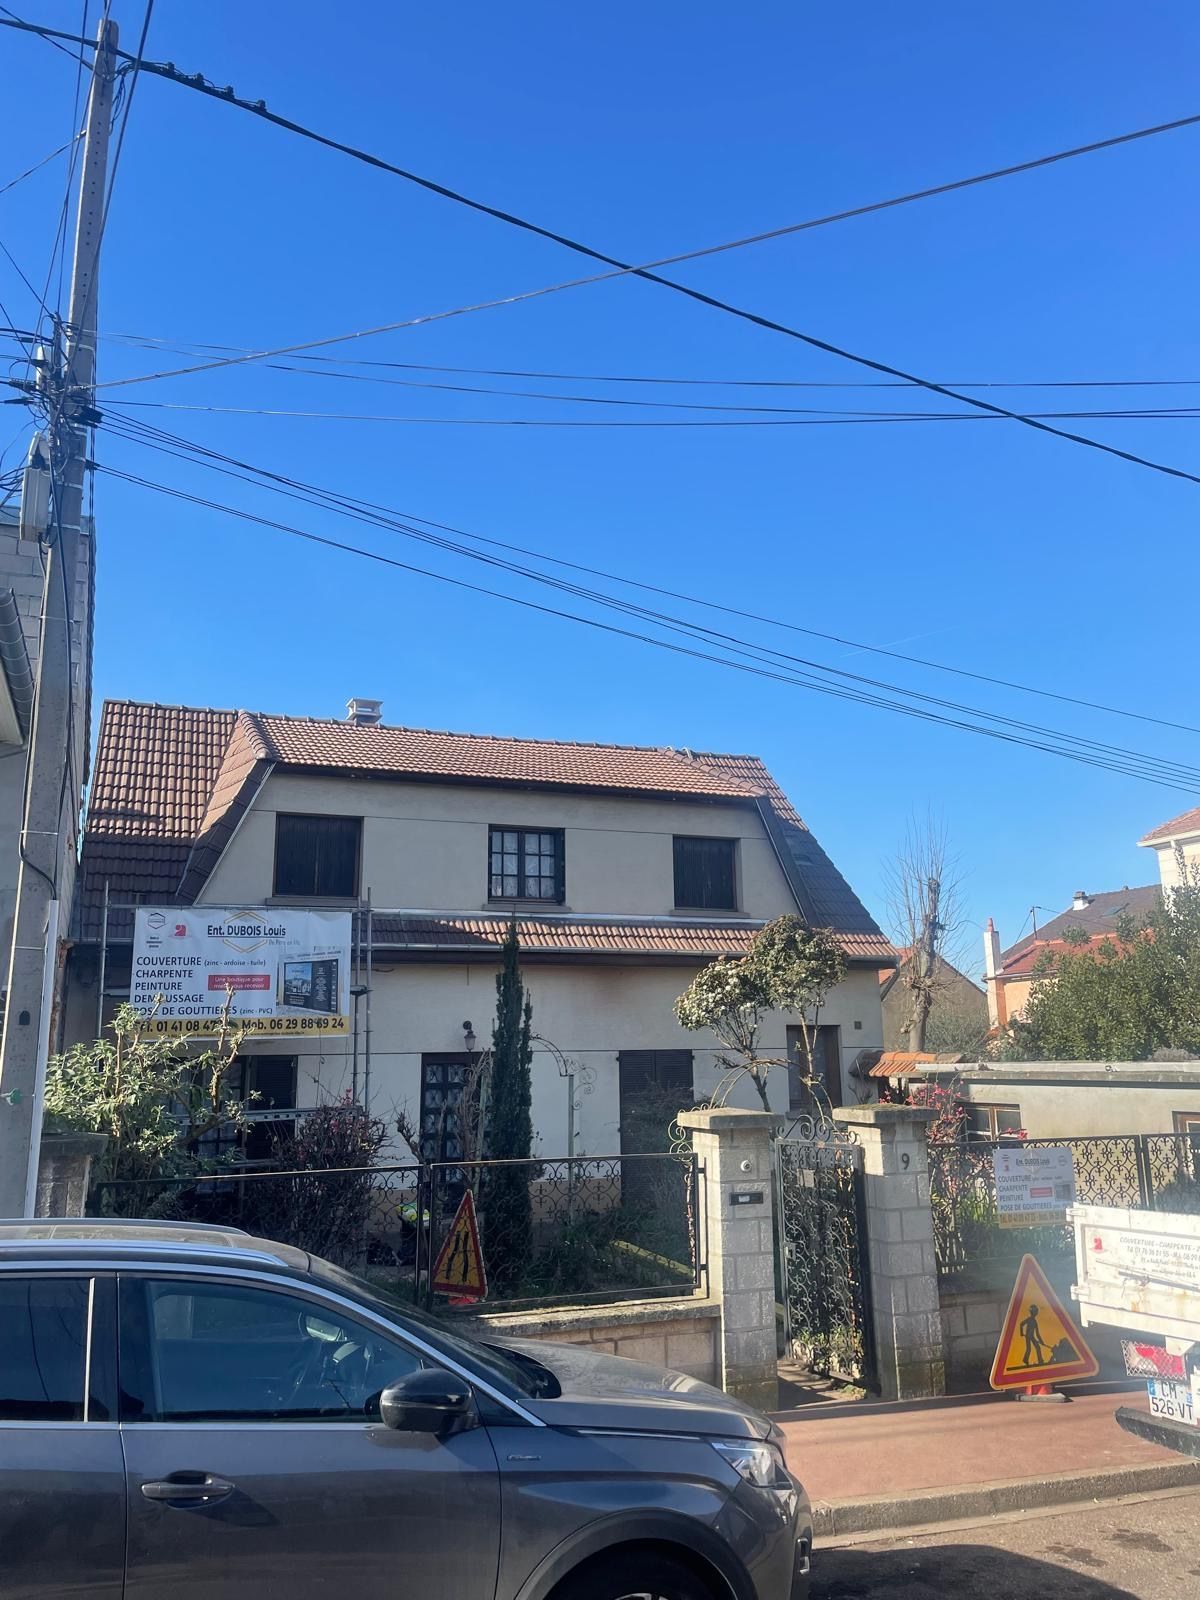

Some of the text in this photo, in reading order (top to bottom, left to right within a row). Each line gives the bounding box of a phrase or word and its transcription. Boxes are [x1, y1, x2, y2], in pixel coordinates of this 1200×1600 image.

[207, 924, 286, 936] Ent. DUBOIS Louis
[136, 956, 202, 966] COUVERTURE
[135, 969, 193, 978] CHARPENTE
[135, 981, 182, 990] PEINTURE
[134, 994, 204, 1003] DEMUSSAGE
[162, 1006, 175, 1015] DE
[156, 1020, 167, 1032] 01
[171, 1020, 182, 1031] 41
[186, 1020, 200, 1031] 08
[202, 1020, 215, 1031] 47
[241, 1019, 267, 1030] Mob.
[270, 1019, 283, 1029] 06
[285, 1018, 298, 1029] 29
[300, 1018, 314, 1029] 88
[331, 1017, 344, 1028] 24
[901, 1153, 910, 1170] 9
[998, 1174, 1032, 1183] COUVERTURE
[998, 1184, 1028, 1192] CHARPENTE
[999, 1194, 1024, 1202] PEINTURE
[1119, 1236, 1155, 1247] COUVERTURE
[1151, 1396, 1193, 1420] 526-VT
